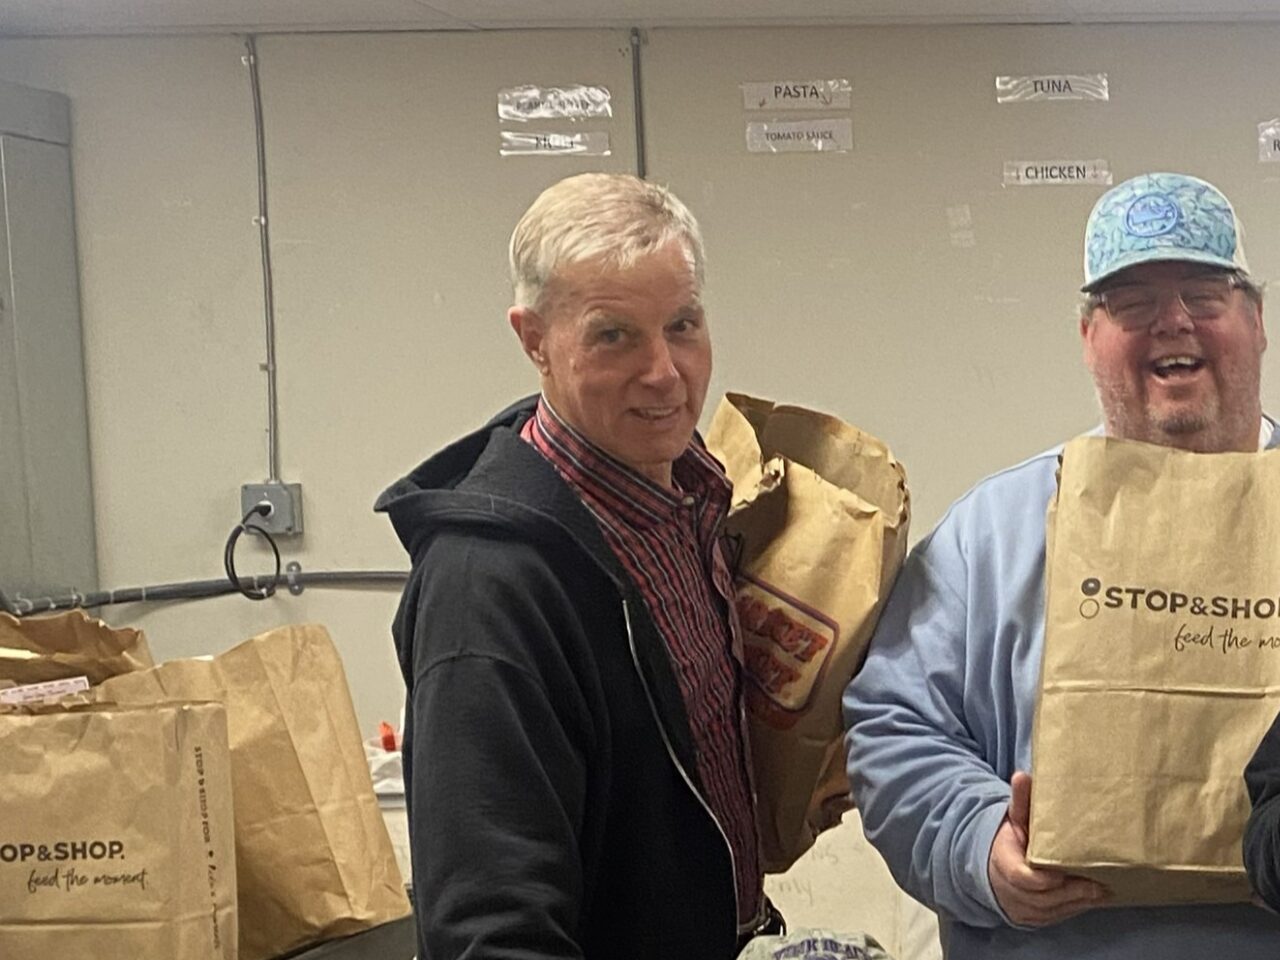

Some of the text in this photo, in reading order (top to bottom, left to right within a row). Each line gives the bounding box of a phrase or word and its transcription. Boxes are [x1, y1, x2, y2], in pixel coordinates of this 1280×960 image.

[774, 85, 820, 99] PASTA
[1032, 79, 1073, 94] TUNA
[765, 130, 833, 141] TOMATO SAUCE
[1024, 165, 1087, 180] CHICKEN
[1174, 623, 1214, 652] feed
[1218, 627, 1252, 654] the
[27, 868, 60, 894] feed
[62, 867, 89, 892] the
